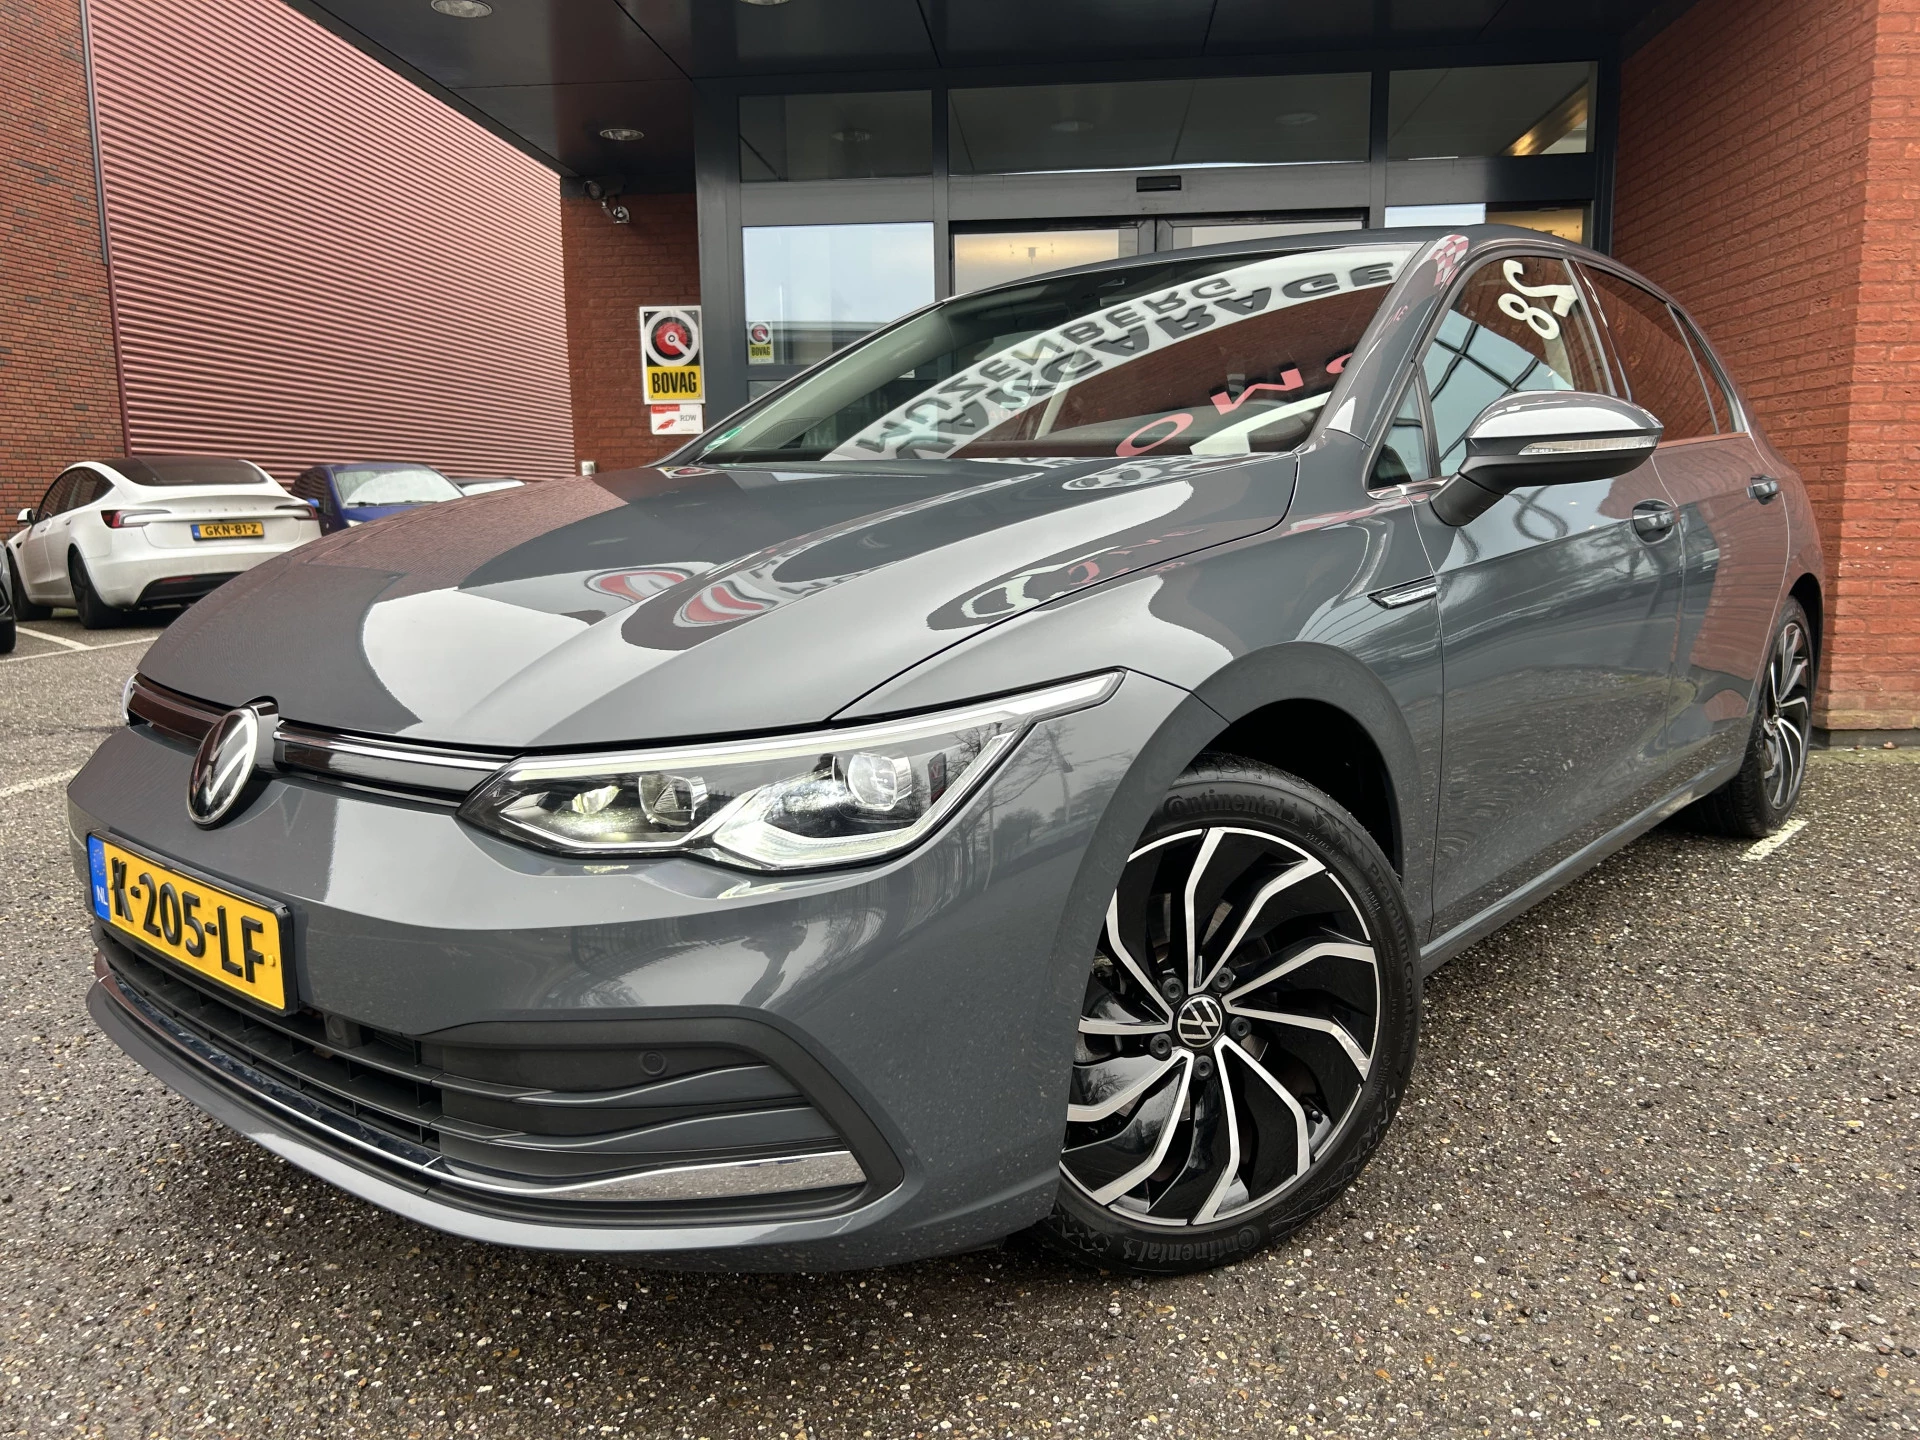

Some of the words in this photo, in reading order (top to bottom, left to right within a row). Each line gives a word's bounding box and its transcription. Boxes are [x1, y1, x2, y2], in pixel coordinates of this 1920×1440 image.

[751, 346, 771, 357] BOVAG
[651, 371, 697, 394] BOVAG
[679, 414, 697, 422] RDW
[205, 524, 259, 536] GKN-81-Z
[1163, 789, 1285, 820] Continental
[96, 884, 109, 906] NL
[111, 857, 265, 984] K-205-LF
[1135, 1225, 1262, 1264] Continental
